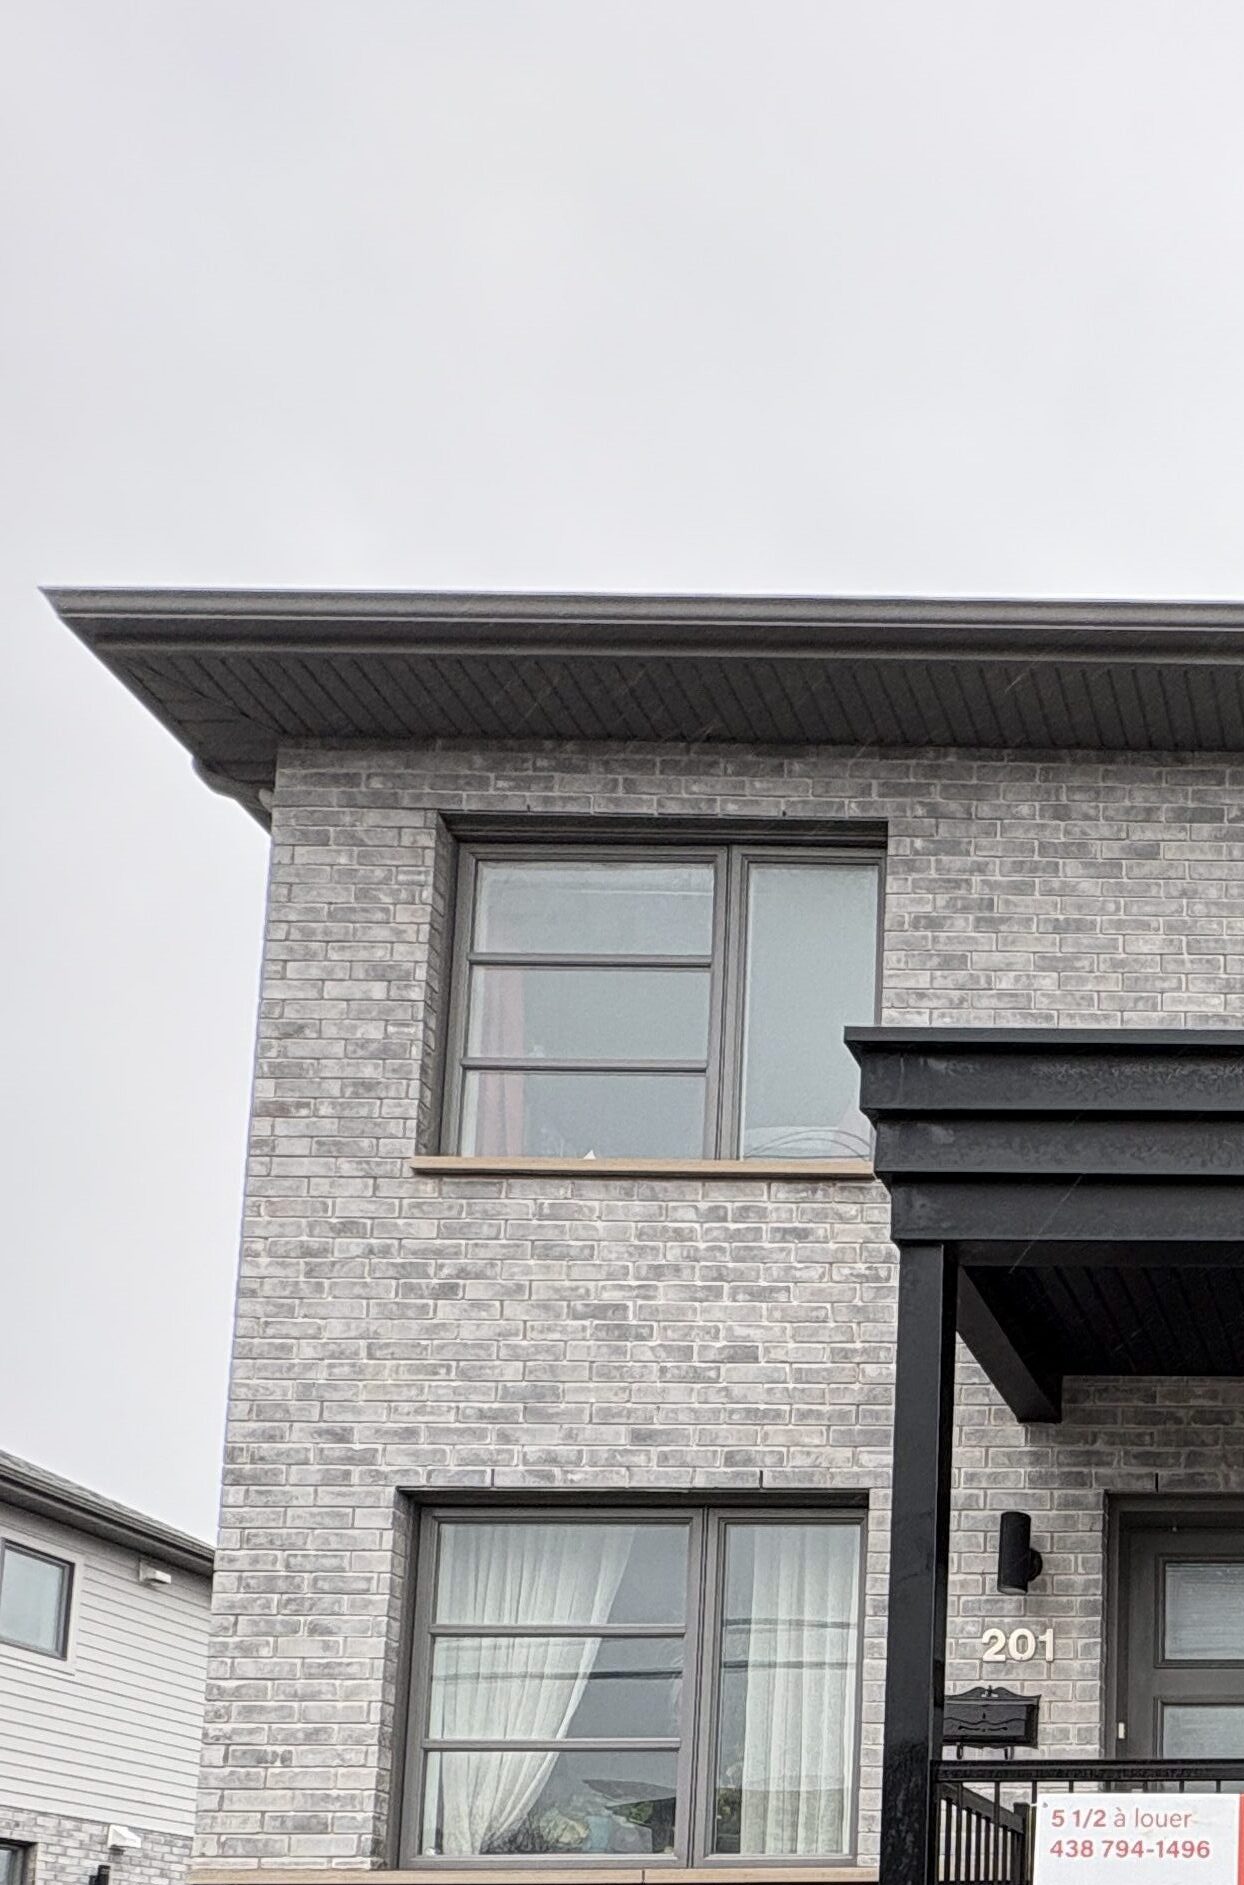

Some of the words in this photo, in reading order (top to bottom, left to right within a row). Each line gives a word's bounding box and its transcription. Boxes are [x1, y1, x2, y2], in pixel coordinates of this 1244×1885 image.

[980, 1627, 1054, 1662] 201
[1051, 1809, 1065, 1828] 5
[1072, 1809, 1106, 1829] 1/2
[1113, 1806, 1126, 1828] à
[1135, 1807, 1193, 1828] louer
[1050, 1839, 1094, 1858] 438
[1101, 1839, 1211, 1859] 794-1496
